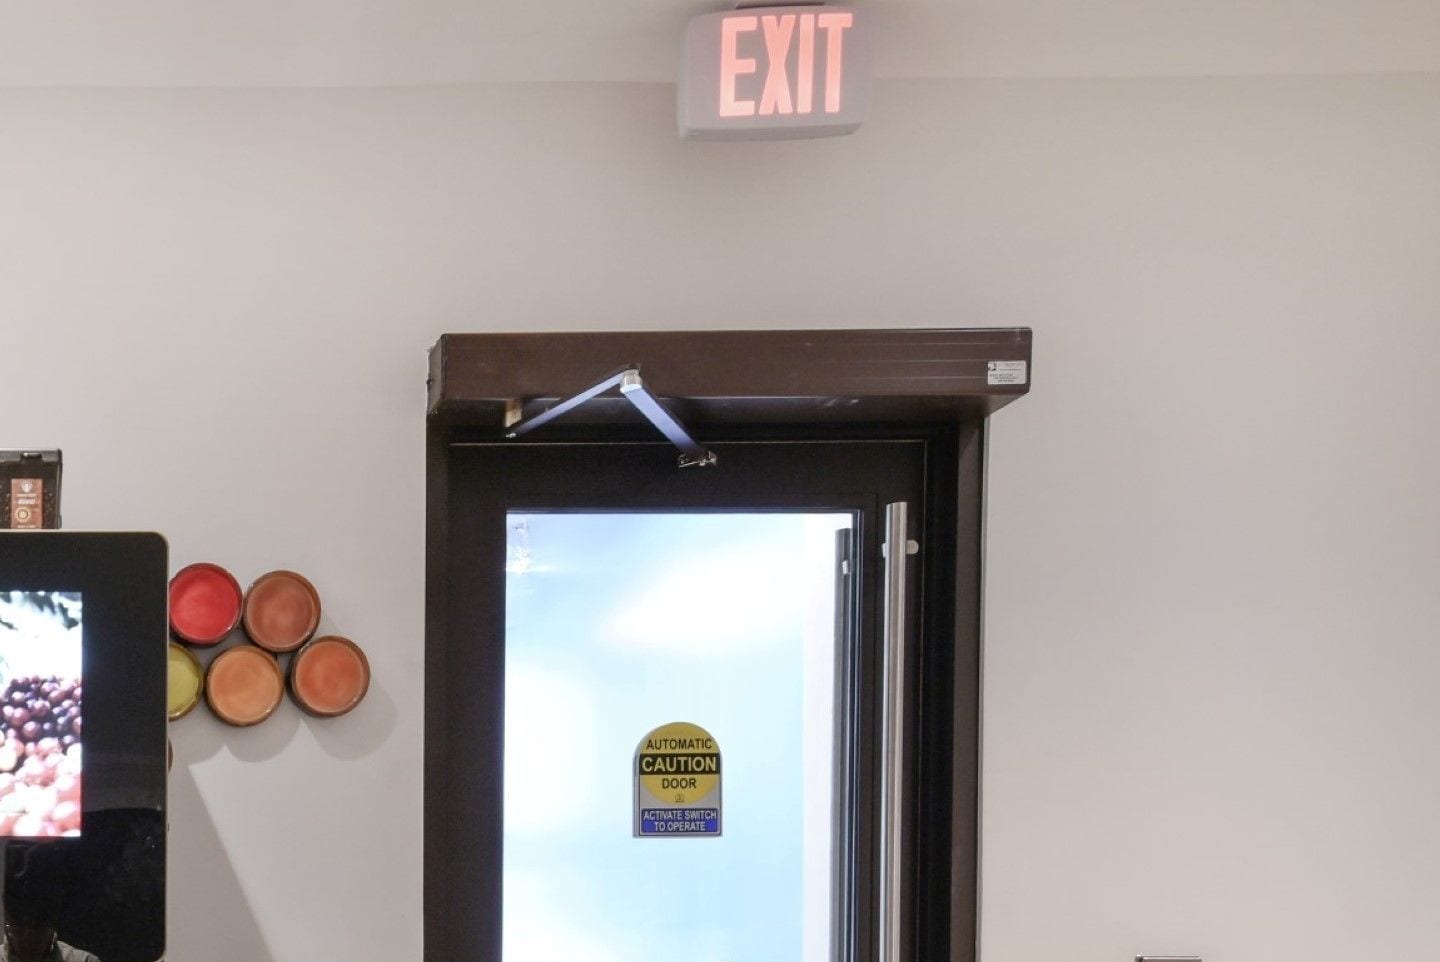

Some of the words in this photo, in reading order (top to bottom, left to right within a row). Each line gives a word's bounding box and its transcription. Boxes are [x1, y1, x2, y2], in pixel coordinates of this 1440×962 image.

[719, 13, 853, 117] EXIT
[646, 738, 712, 750] AUTOMATIC
[641, 756, 717, 772] CAUTION
[662, 778, 697, 789] DOOR
[643, 810, 682, 820] ACTIVATE
[684, 810, 717, 820] SWITCH
[654, 821, 665, 832] TO
[667, 821, 706, 832] OPERATE
